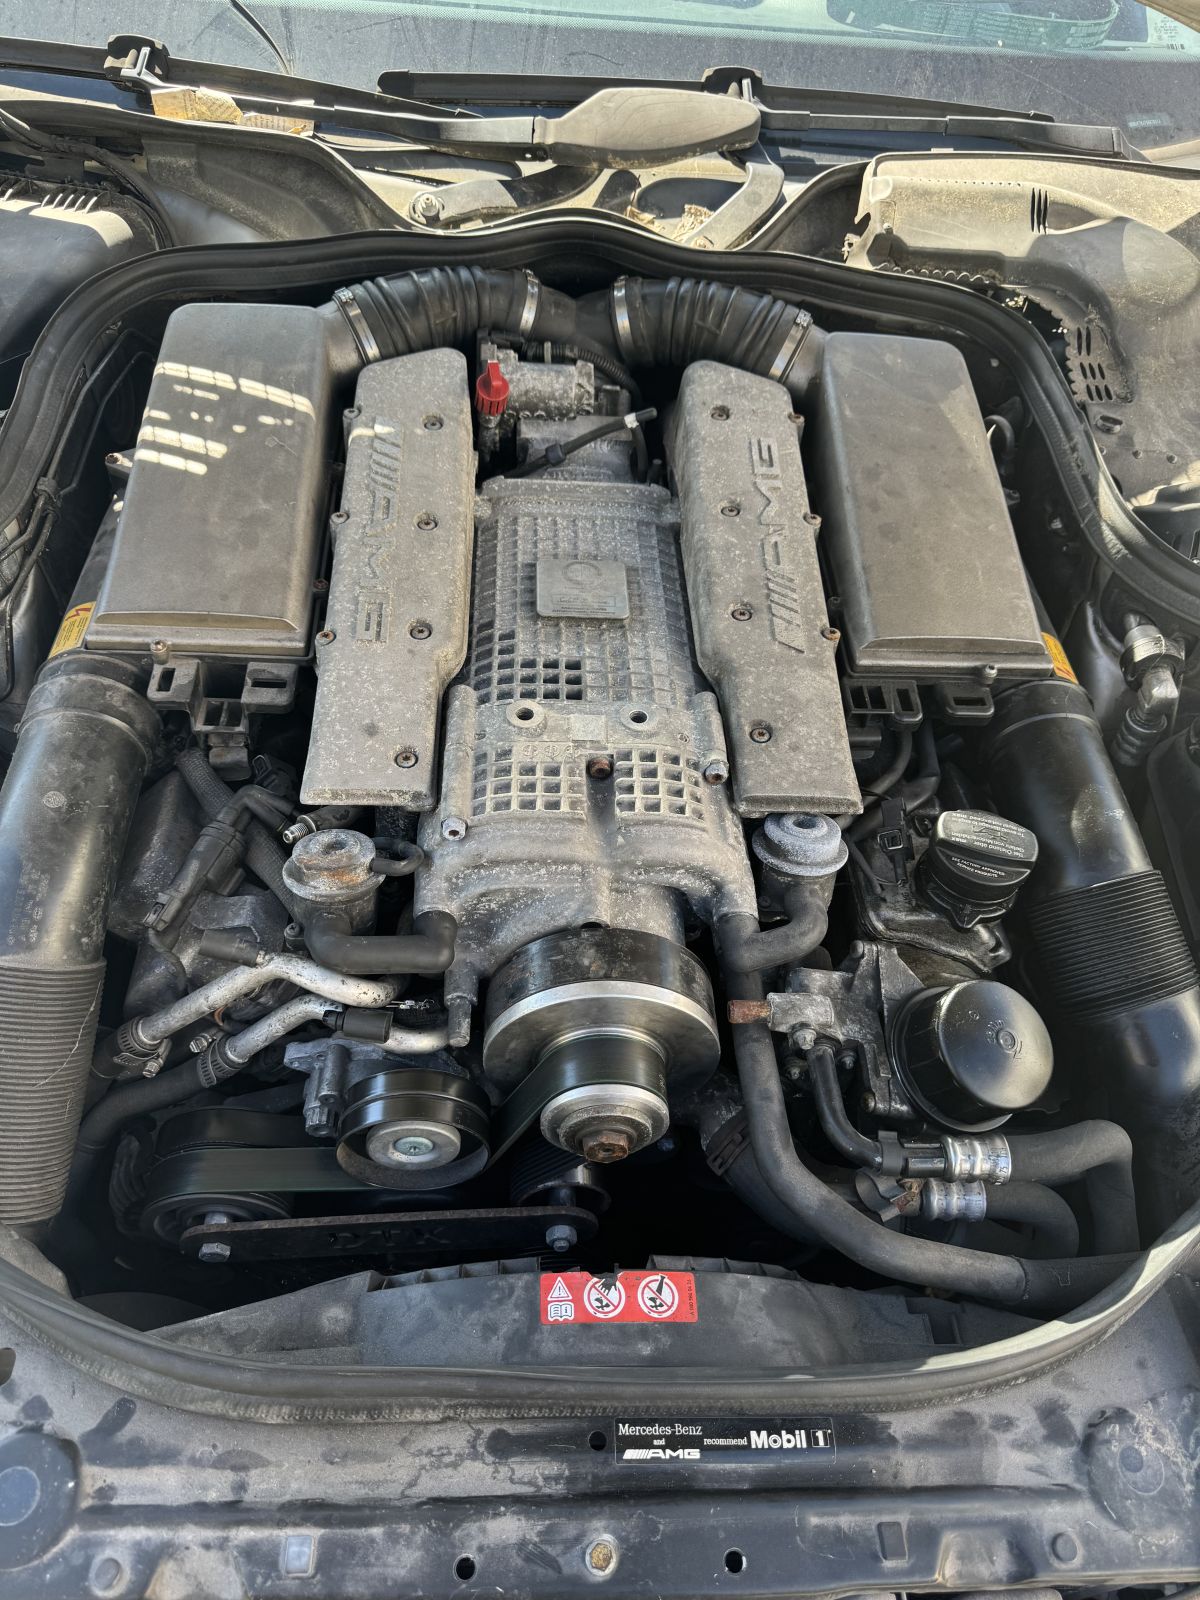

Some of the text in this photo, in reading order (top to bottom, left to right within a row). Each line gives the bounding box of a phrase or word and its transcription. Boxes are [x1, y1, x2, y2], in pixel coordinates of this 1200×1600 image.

[749, 437, 795, 582] AMG
[356, 489, 400, 643] AMG
[618, 1423, 703, 1436] Mercedes-Benz
[704, 1430, 828, 1449] recommend Mobil 1
[647, 1449, 701, 1459] AMG
